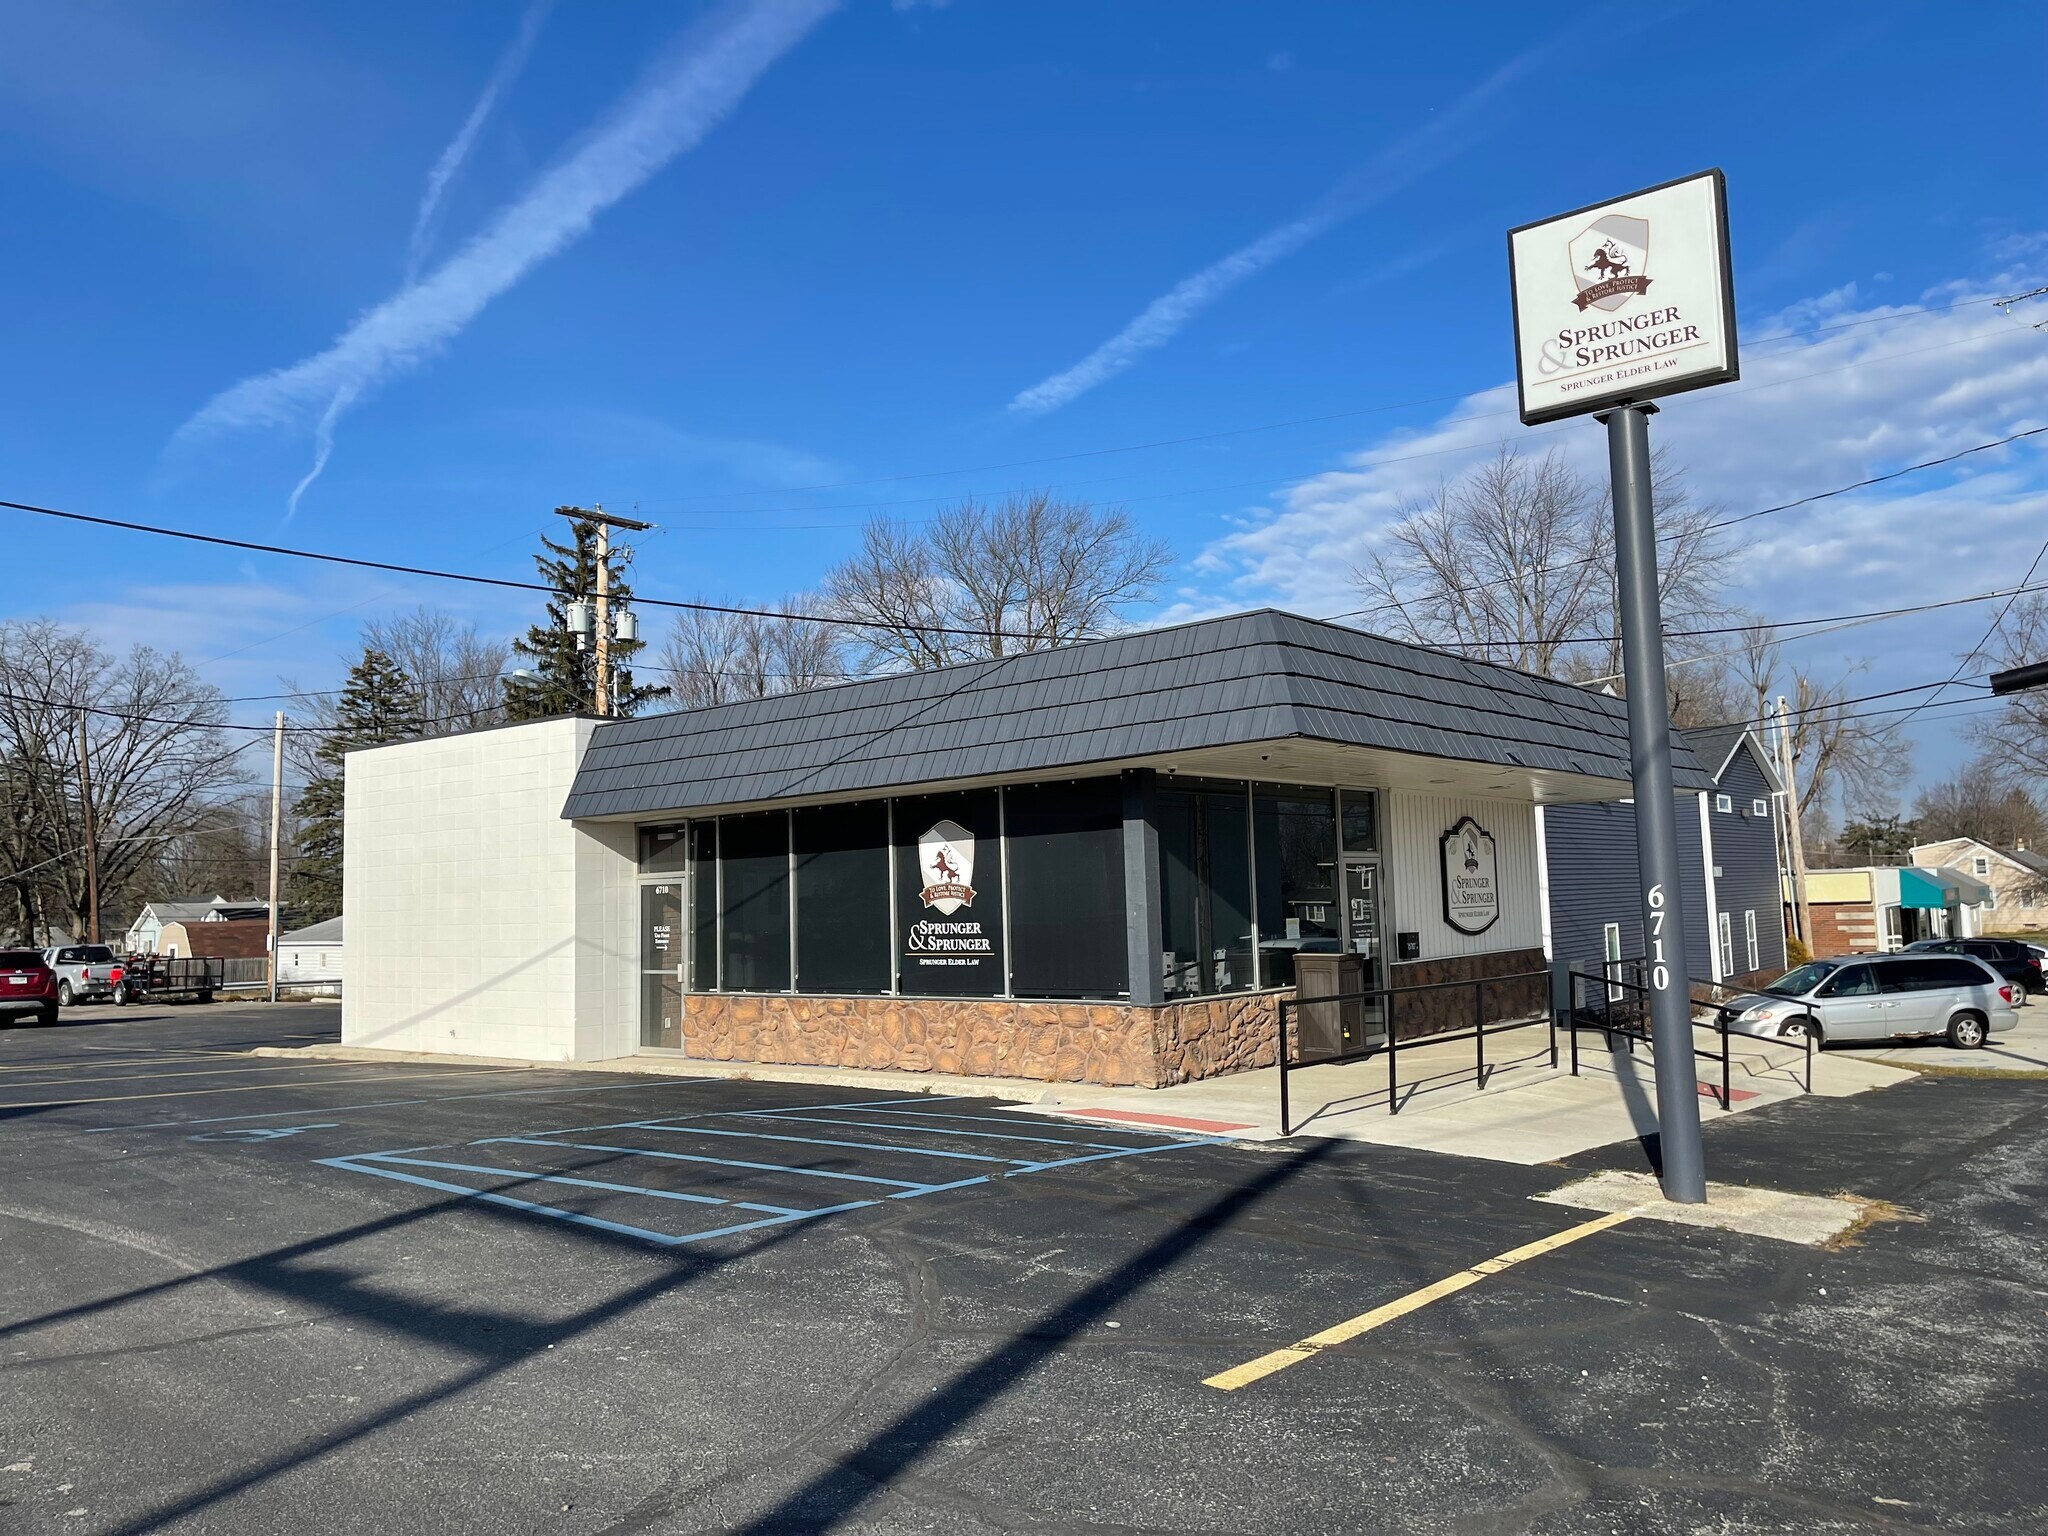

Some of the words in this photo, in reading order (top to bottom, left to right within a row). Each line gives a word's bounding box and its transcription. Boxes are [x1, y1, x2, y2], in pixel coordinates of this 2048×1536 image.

[1612, 278, 1639, 287] PROTECT
[1592, 287, 1615, 299] RESTORE
[1616, 283, 1638, 291] JUSTICE
[1558, 306, 1681, 350] SPRUNGER
[1537, 338, 1573, 375] &
[1575, 325, 1700, 368] SPRUNGER
[1560, 373, 1614, 393] SPRUNGER
[1616, 365, 1652, 380] ELDER
[1654, 357, 1679, 371] LAW
[1456, 874, 1490, 889] SPRUNGER
[655, 885, 669, 895] 6710
[1450, 879, 1463, 905] &
[1461, 890, 1495, 905] SPRUNGER
[653, 925, 671, 933] PLEASE
[919, 919, 982, 935] SPRUNGER
[908, 924, 928, 951] &
[927, 935, 991, 951] SPRUNGER
[1647, 883, 1670, 991] 6710
[919, 958, 948, 966] SPRUNGER
[947, 958, 967, 966] ELDER
[966, 958, 980, 966] LAW
